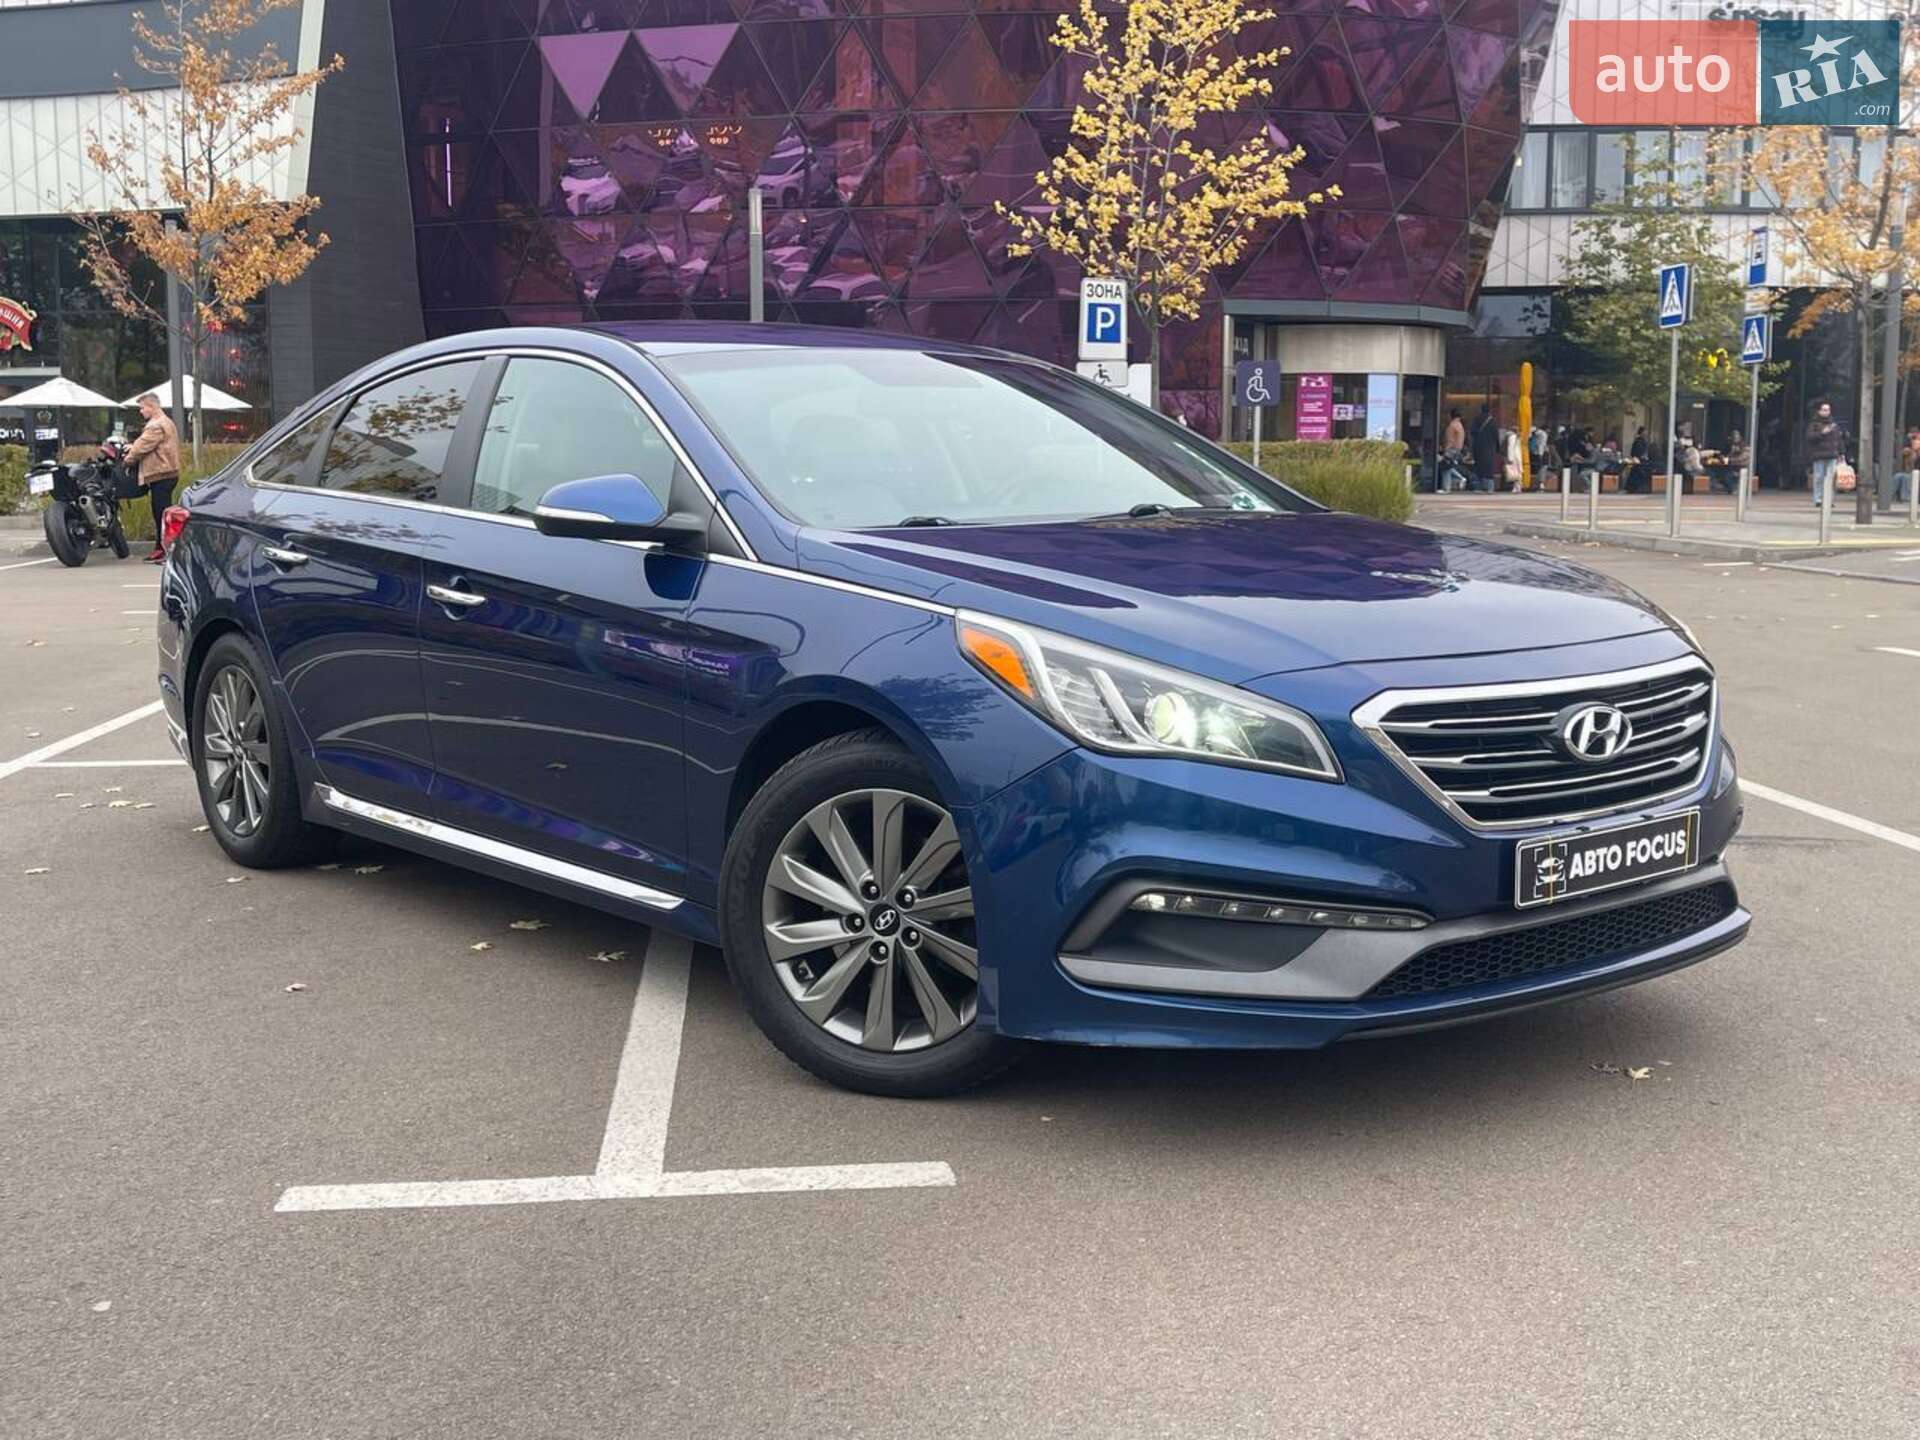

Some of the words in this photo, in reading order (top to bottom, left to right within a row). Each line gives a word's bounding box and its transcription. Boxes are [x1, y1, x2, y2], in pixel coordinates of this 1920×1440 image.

[1086, 283, 1123, 299] ЗОНА
[1095, 306, 1116, 340] P
[1569, 844, 1622, 880] АВТО
[1626, 829, 1687, 867] FOCUS
